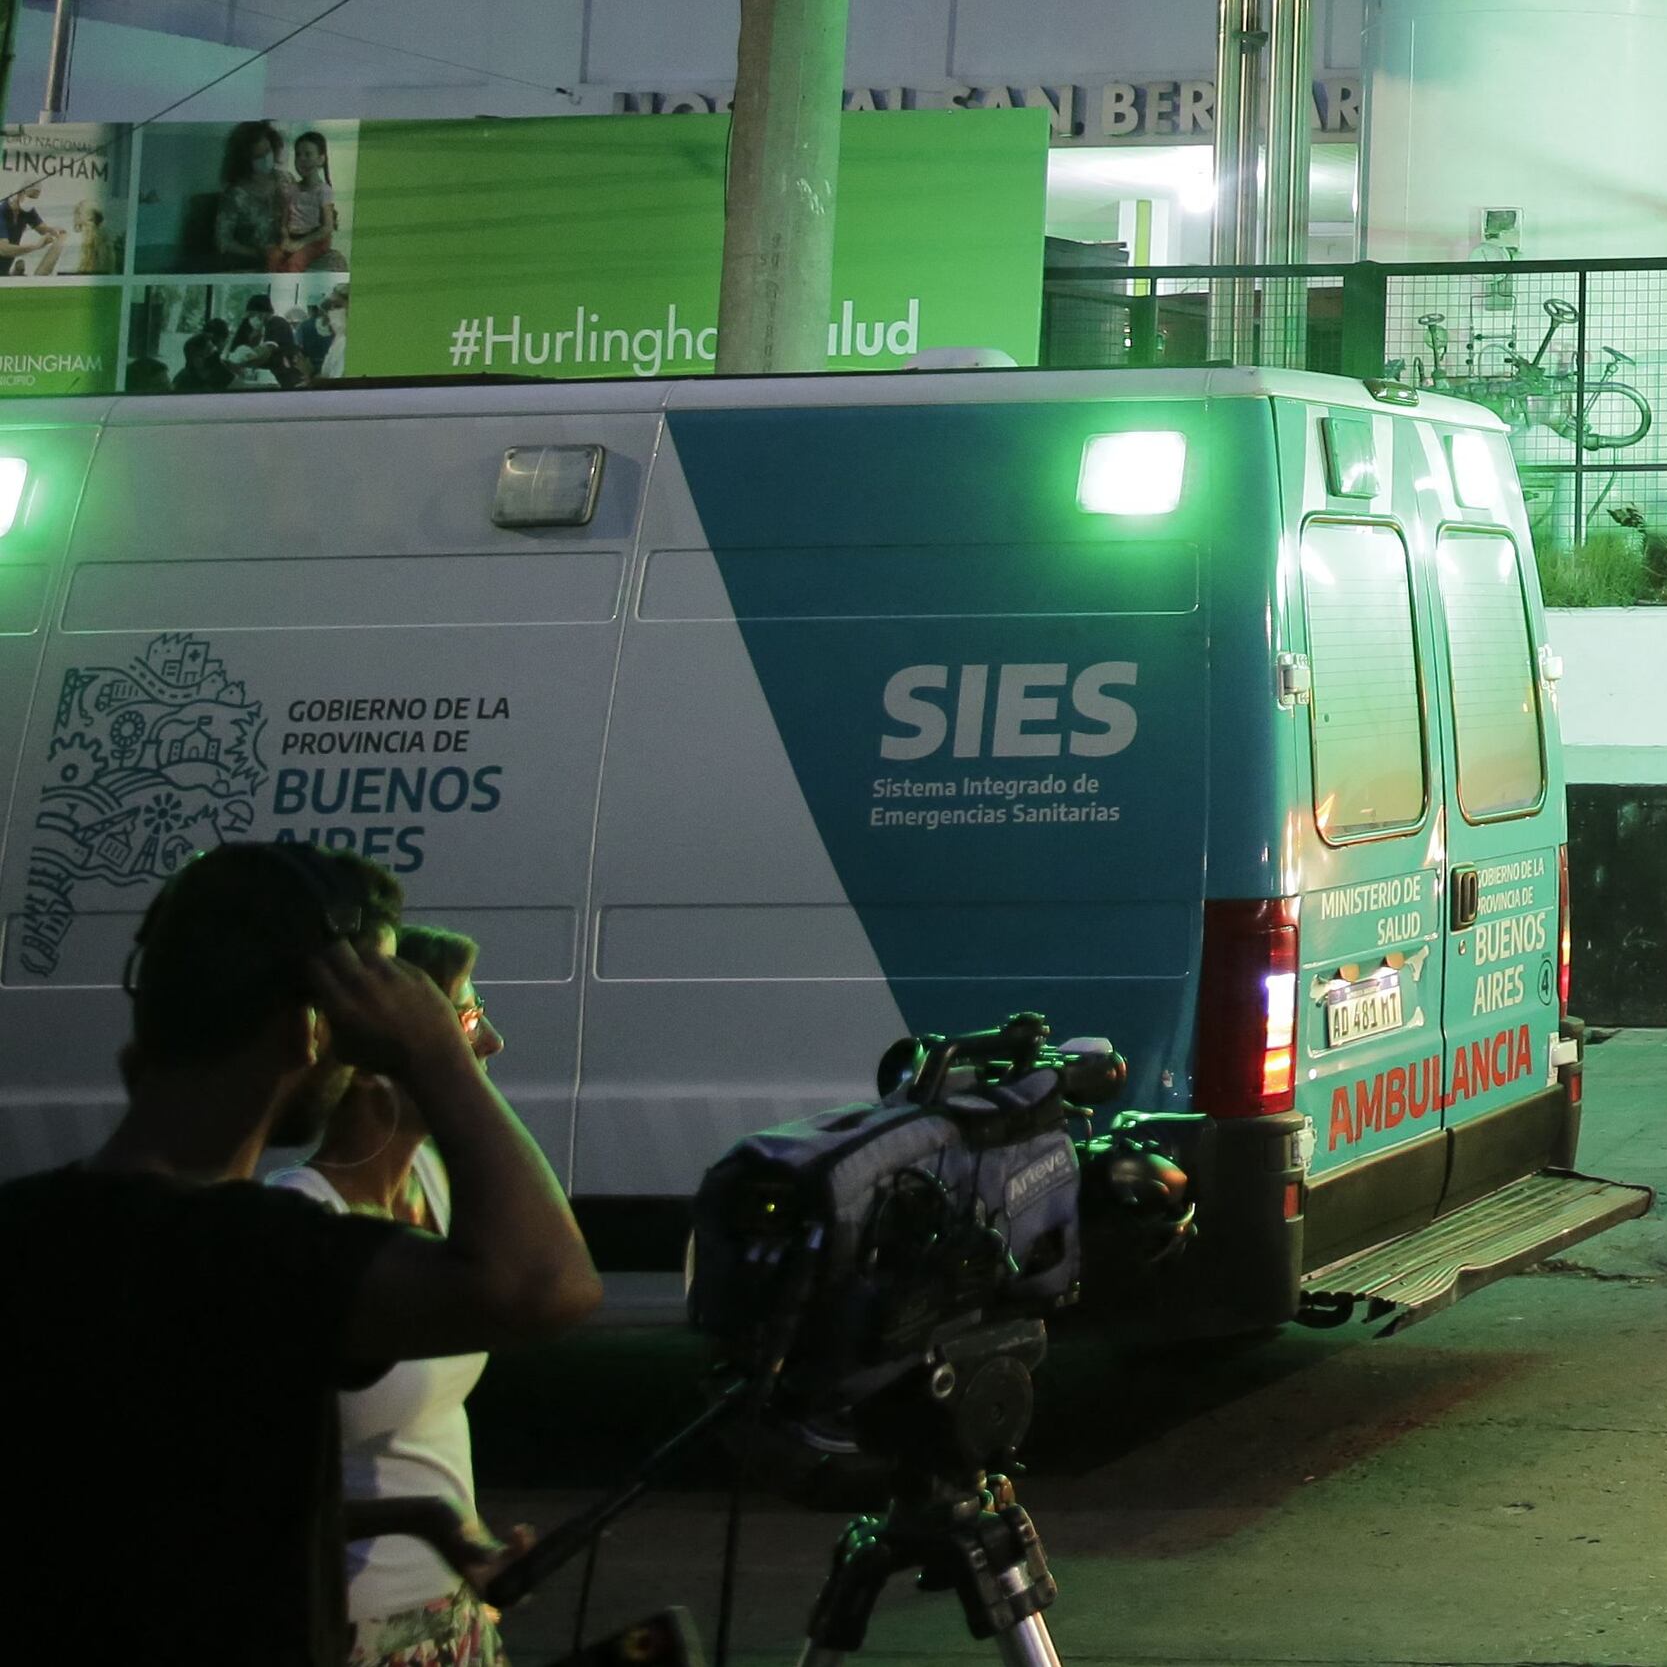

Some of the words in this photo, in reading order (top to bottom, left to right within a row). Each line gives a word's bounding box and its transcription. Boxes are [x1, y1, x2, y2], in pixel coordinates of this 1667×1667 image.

[288, 698, 427, 723] GOBIERNO
[433, 697, 471, 721] DE
[476, 697, 510, 720] LA
[880, 661, 1139, 762] SIES
[281, 730, 426, 756] PROVINCIA
[433, 729, 470, 753] DE
[272, 765, 503, 816] BUENOS
[872, 778, 957, 799] Sistema
[962, 774, 1068, 801] Integrado
[1073, 773, 1100, 795] de
[869, 804, 1007, 831] Emergencias
[1012, 801, 1121, 824] Sanitarias
[1521, 859, 1533, 880] DE
[1533, 857, 1545, 877] LA
[1321, 879, 1400, 920] MINISTERIO
[1403, 875, 1421, 903] DE
[1522, 885, 1534, 906] DE
[1377, 911, 1421, 946] SALUD
[1475, 913, 1545, 966] BUENOS
[1473, 964, 1525, 1017] AIRES
[1541, 969, 1549, 996] 4
[1333, 1006, 1349, 1039] AD
[1354, 997, 1378, 1032] 481
[1328, 1024, 1533, 1152] AMBULANCIA
